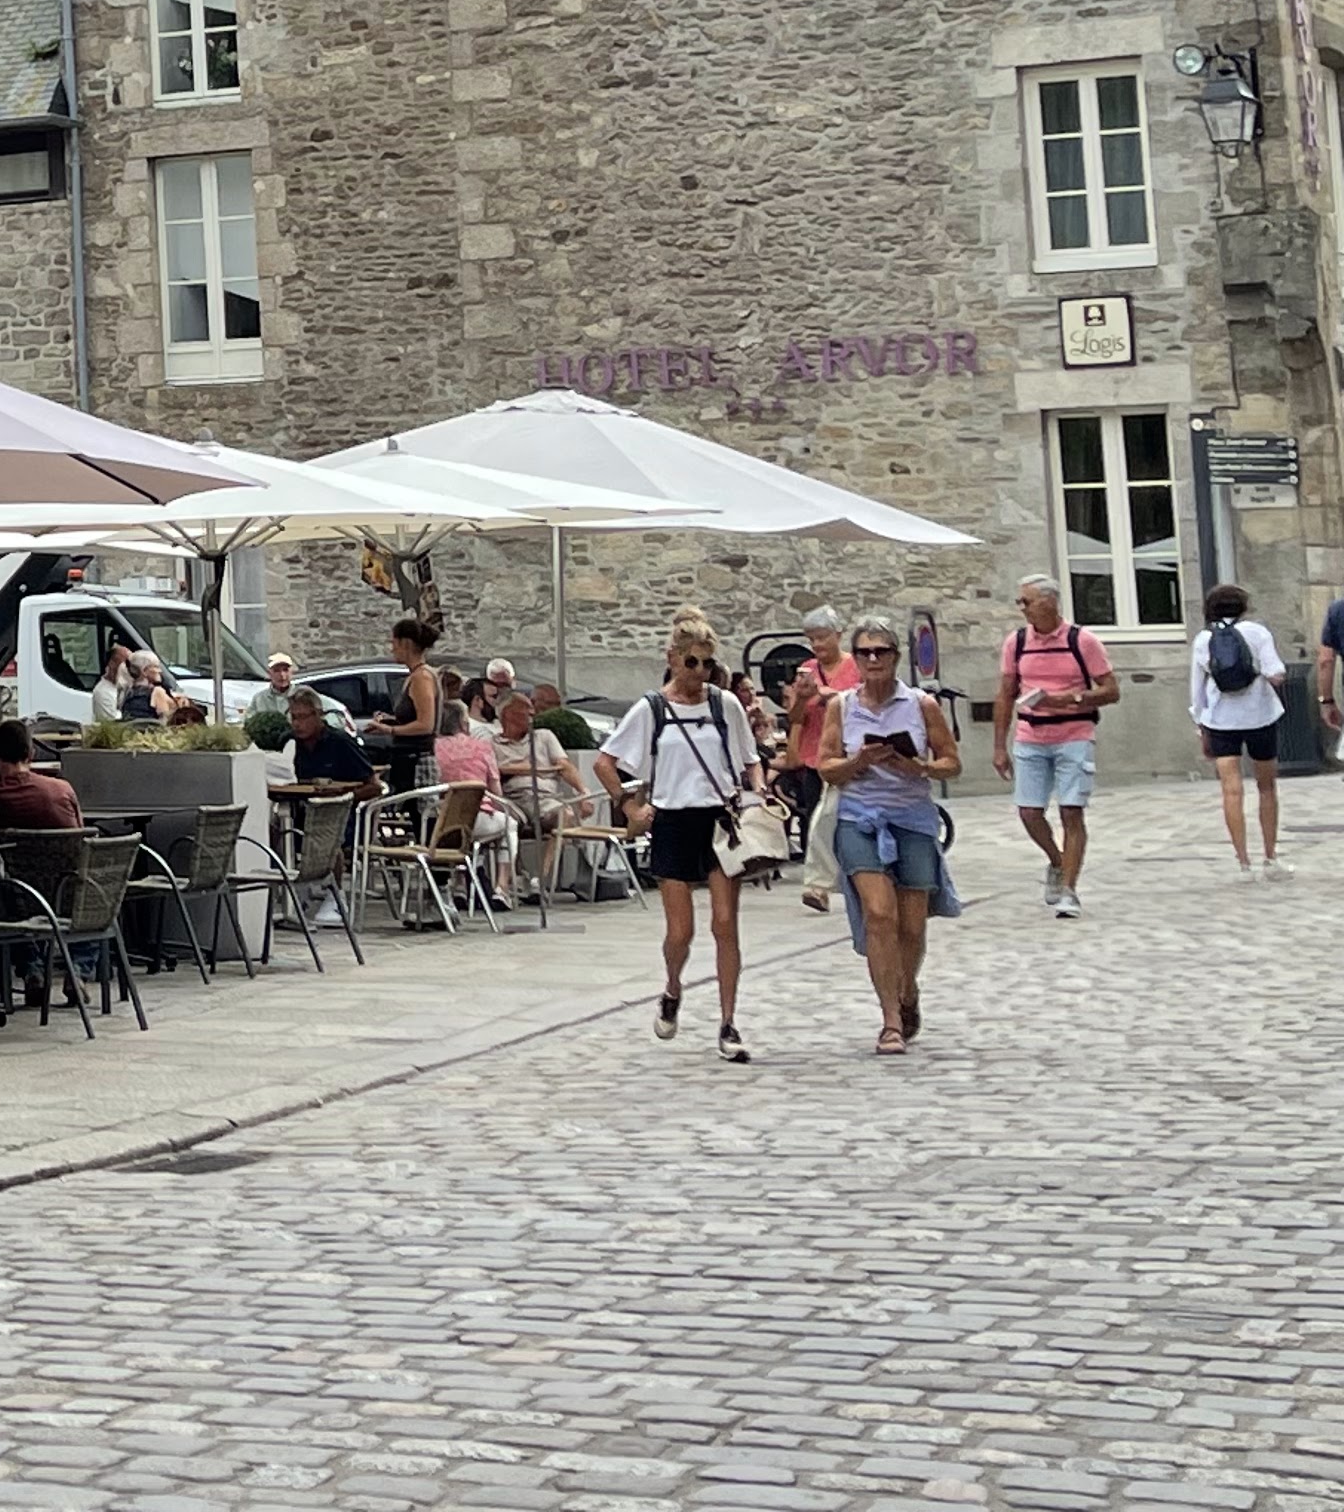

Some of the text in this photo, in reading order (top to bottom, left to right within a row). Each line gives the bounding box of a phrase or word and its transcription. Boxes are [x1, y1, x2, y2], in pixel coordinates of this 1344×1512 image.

[536, 332, 985, 395] HOTEL ARVOR
[1069, 328, 1126, 359] Logis
